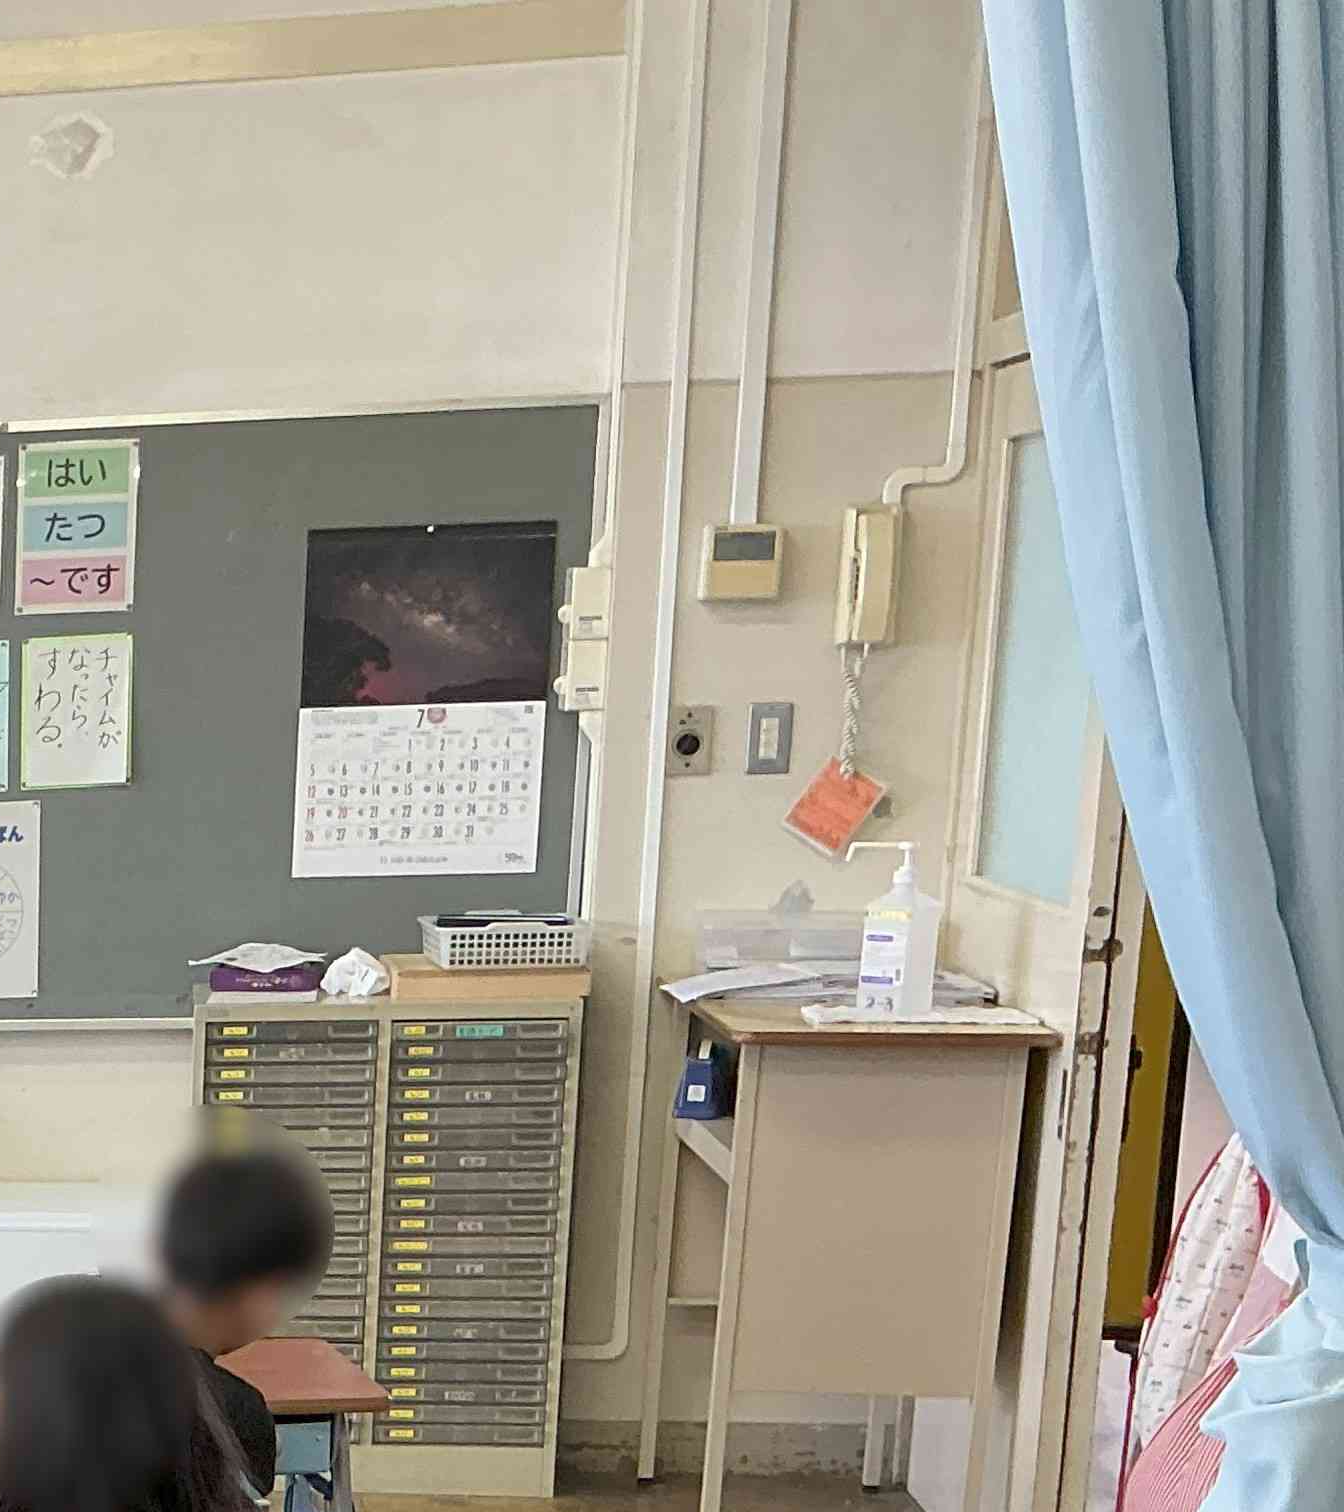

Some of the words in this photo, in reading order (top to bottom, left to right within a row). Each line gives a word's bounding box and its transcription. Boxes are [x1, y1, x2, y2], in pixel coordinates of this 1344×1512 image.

[46, 458, 108, 488] はい
[44, 511, 106, 543] たつ
[95, 647, 122, 749] チャイムが
[416, 708, 425, 728] 7
